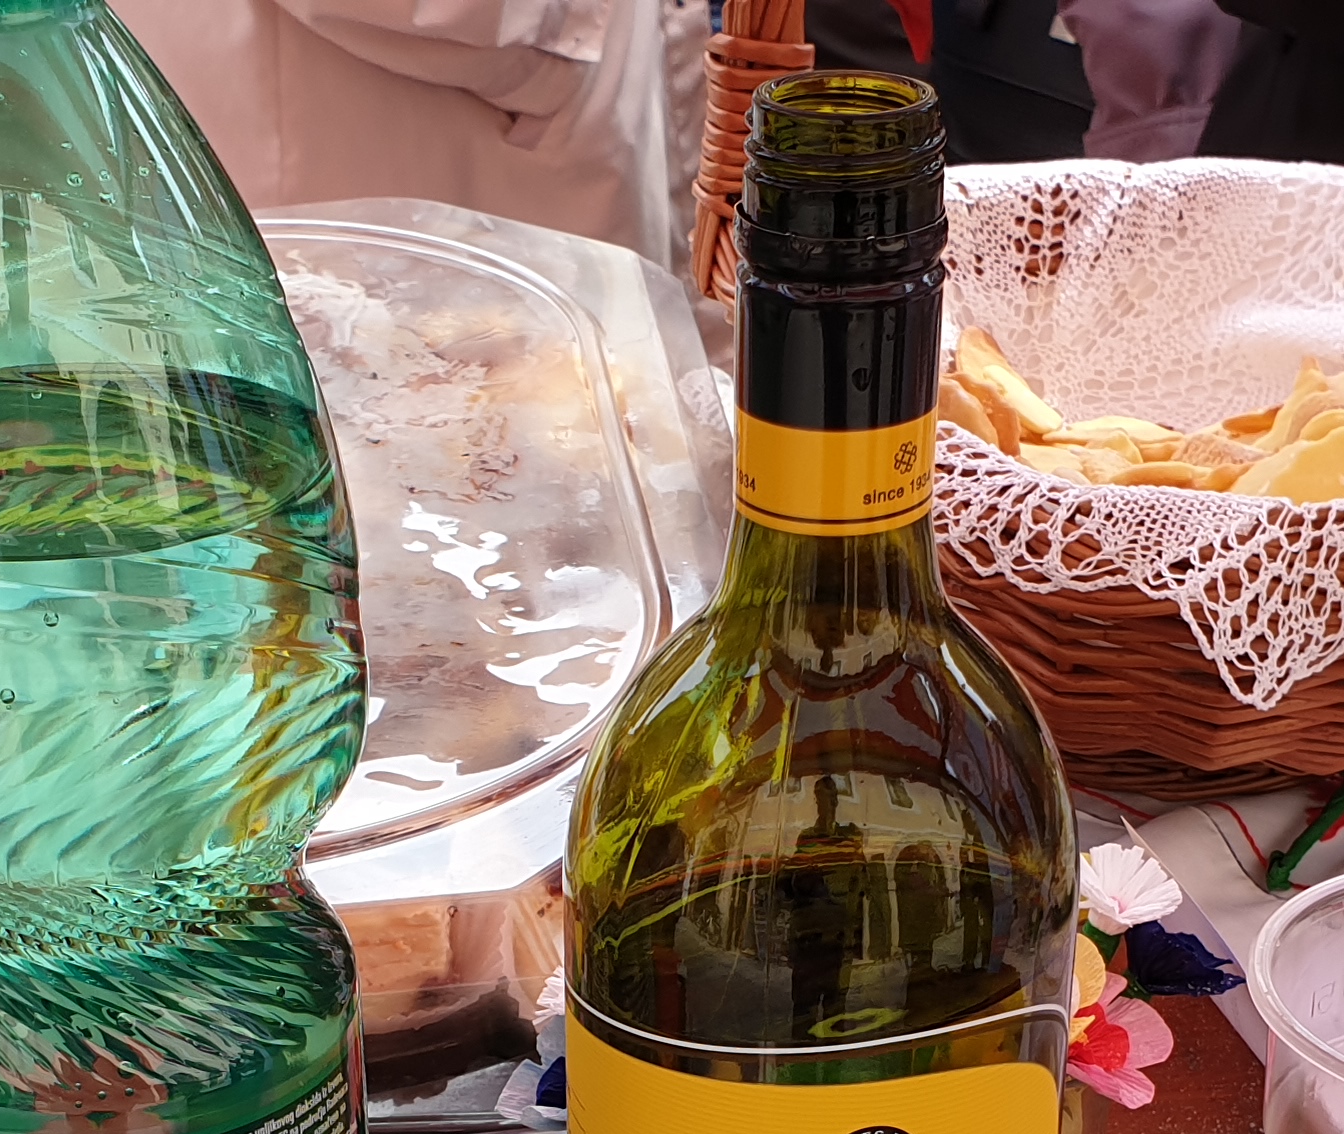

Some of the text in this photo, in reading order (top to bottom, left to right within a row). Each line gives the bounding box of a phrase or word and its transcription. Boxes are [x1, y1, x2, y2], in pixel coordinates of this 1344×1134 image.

[737, 468, 756, 493] 934
[863, 470, 931, 506] since 1934
